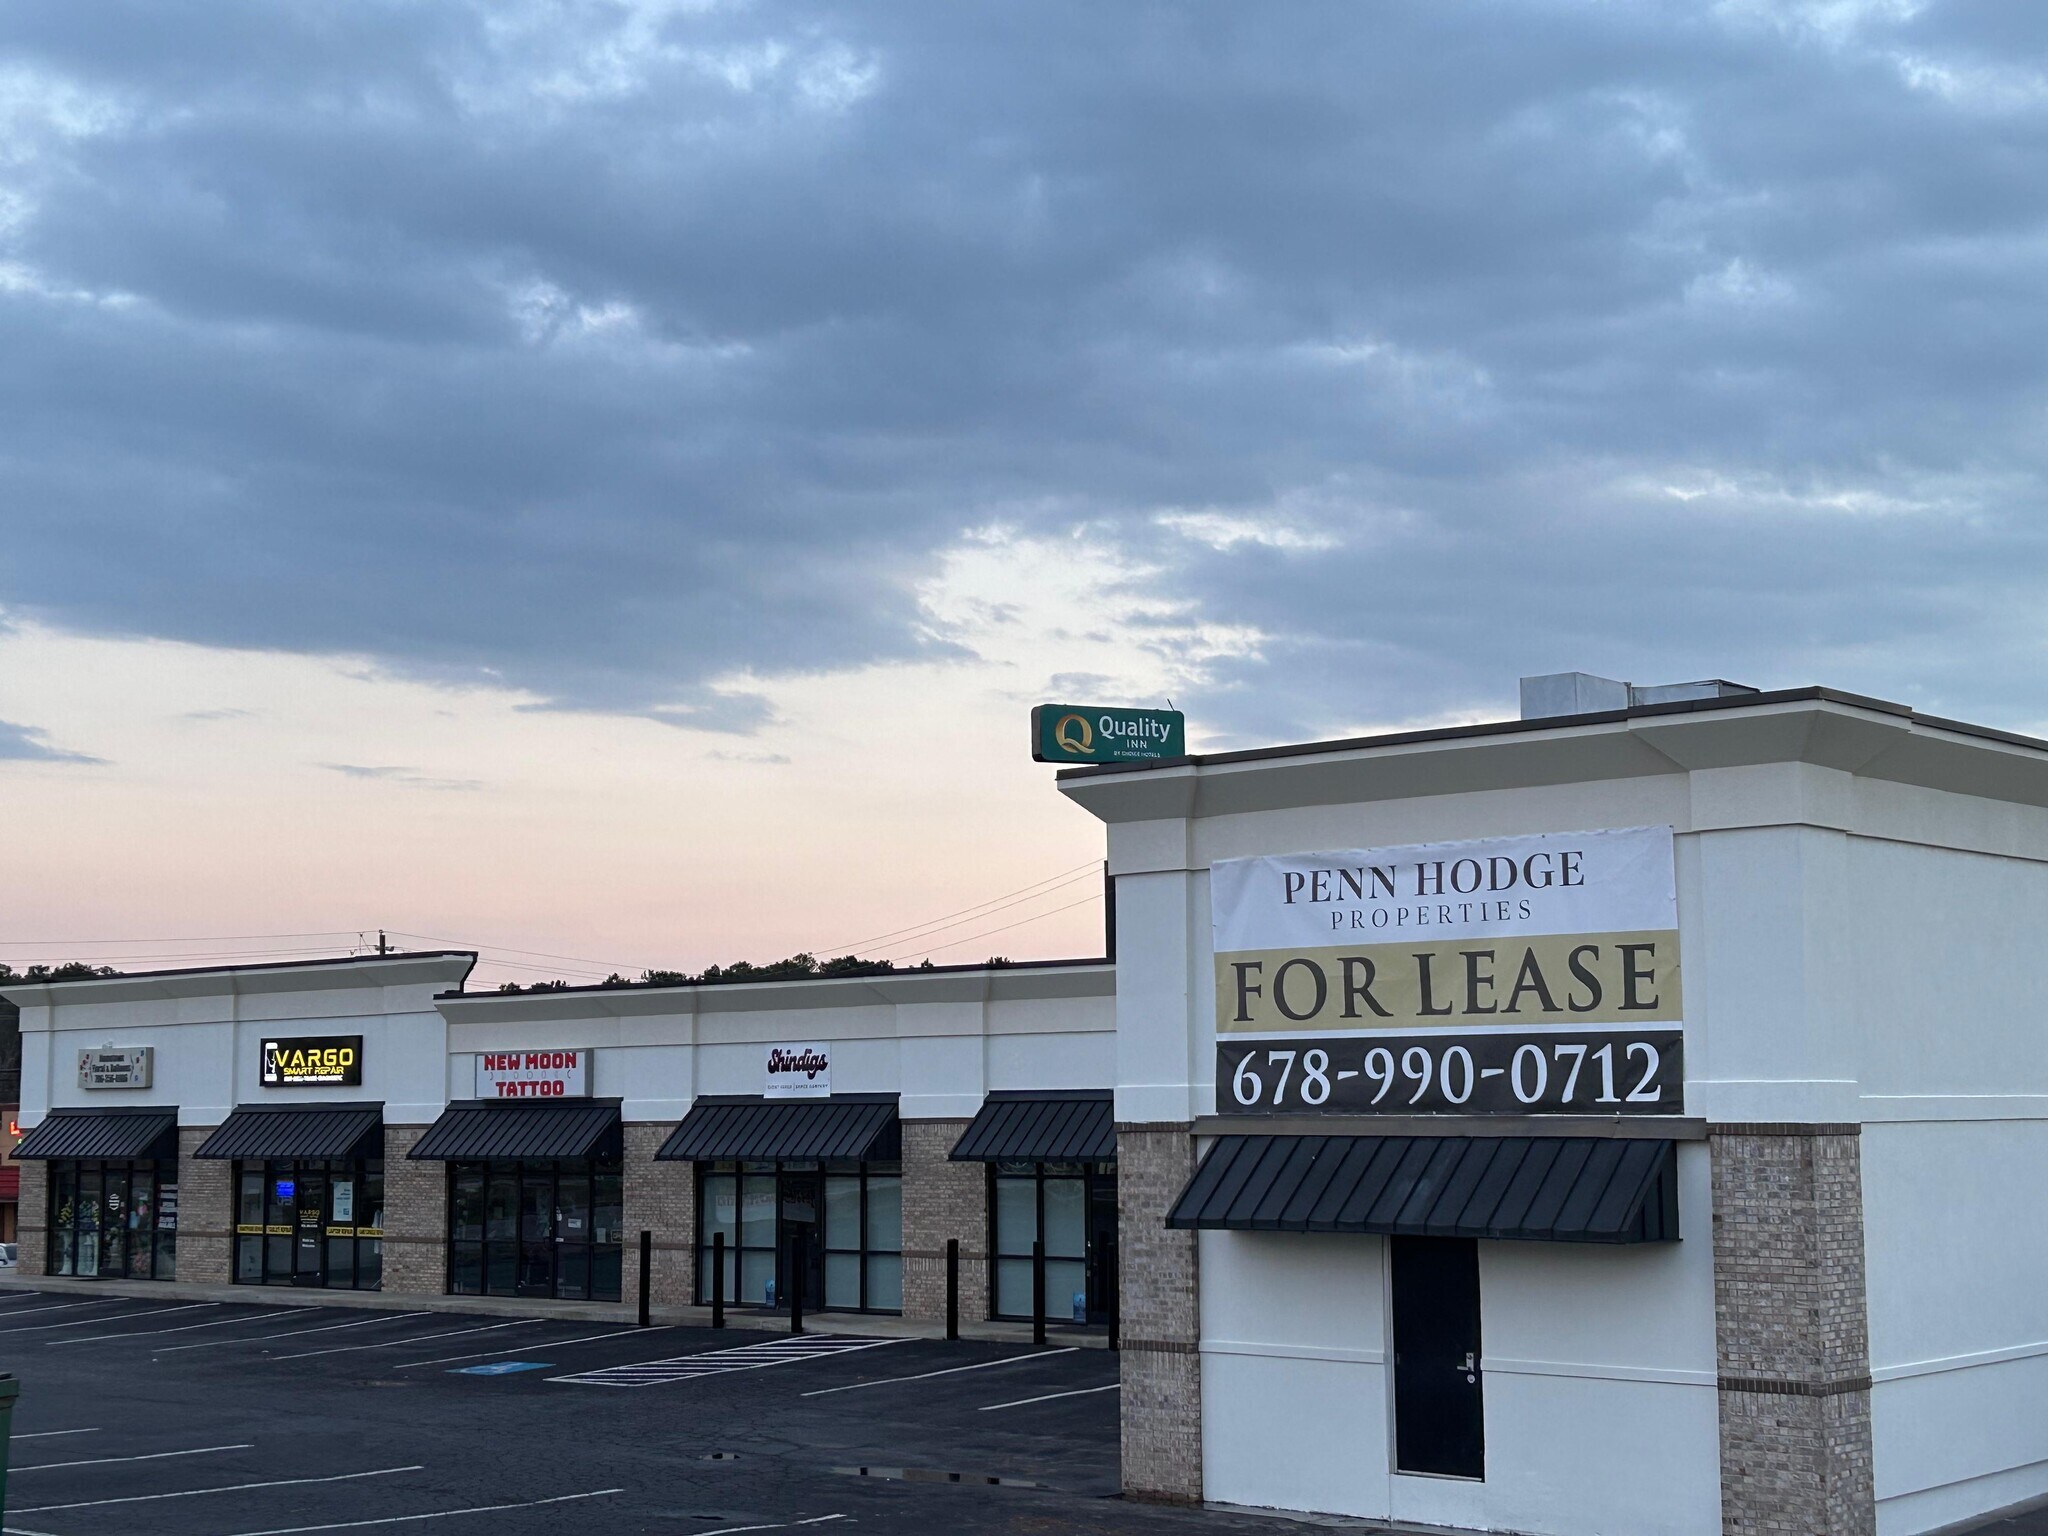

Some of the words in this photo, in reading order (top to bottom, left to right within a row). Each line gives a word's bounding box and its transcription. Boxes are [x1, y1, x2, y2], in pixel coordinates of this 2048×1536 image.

[1099, 715, 1171, 743] Quality
[1126, 739, 1148, 749] INN
[1283, 865, 1397, 905] PENN
[1414, 850, 1586, 896] HODGE
[1331, 899, 1533, 930] PROPERTIES
[1230, 956, 1394, 1023] FOR
[1412, 942, 1660, 1017] LEASE
[275, 1048, 354, 1067] VARGO
[283, 1066, 313, 1076] SMART
[314, 1066, 344, 1075] REPAIR
[484, 1053, 521, 1071] NEW
[525, 1052, 577, 1070] MOON
[767, 1048, 829, 1080] Shindigs
[1232, 1041, 1662, 1106] 678-990-0712
[495, 1080, 564, 1097] TATTOO
